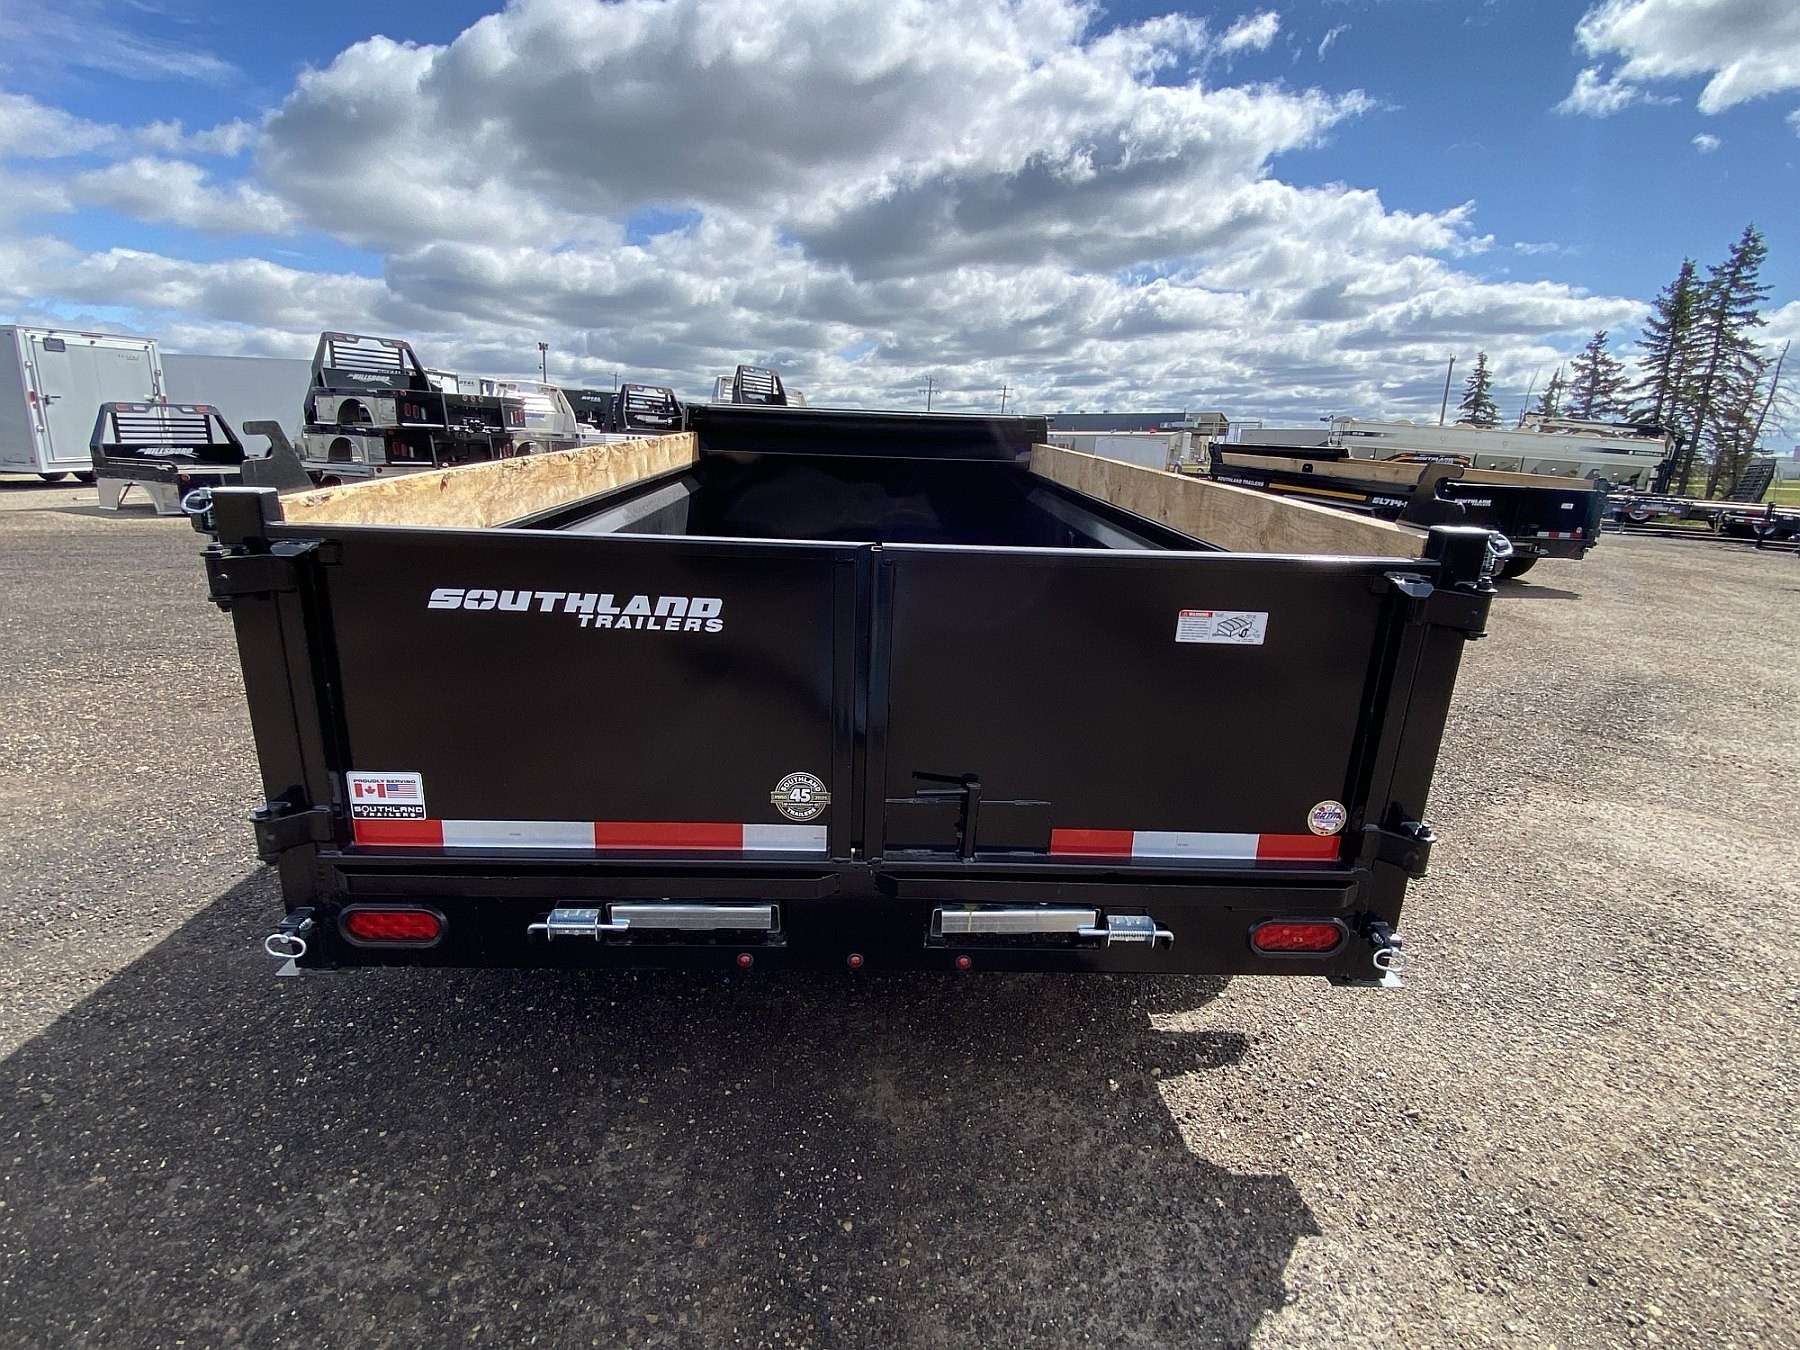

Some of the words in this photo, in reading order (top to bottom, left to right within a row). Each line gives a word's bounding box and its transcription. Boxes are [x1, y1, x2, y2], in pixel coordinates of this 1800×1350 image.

[143, 447, 194, 456] HILLSBORO
[427, 588, 723, 618] SOUTHLAND
[577, 614, 724, 633] TRAILERS
[781, 776, 821, 791] SOUTHLAND
[790, 788, 811, 802] 45
